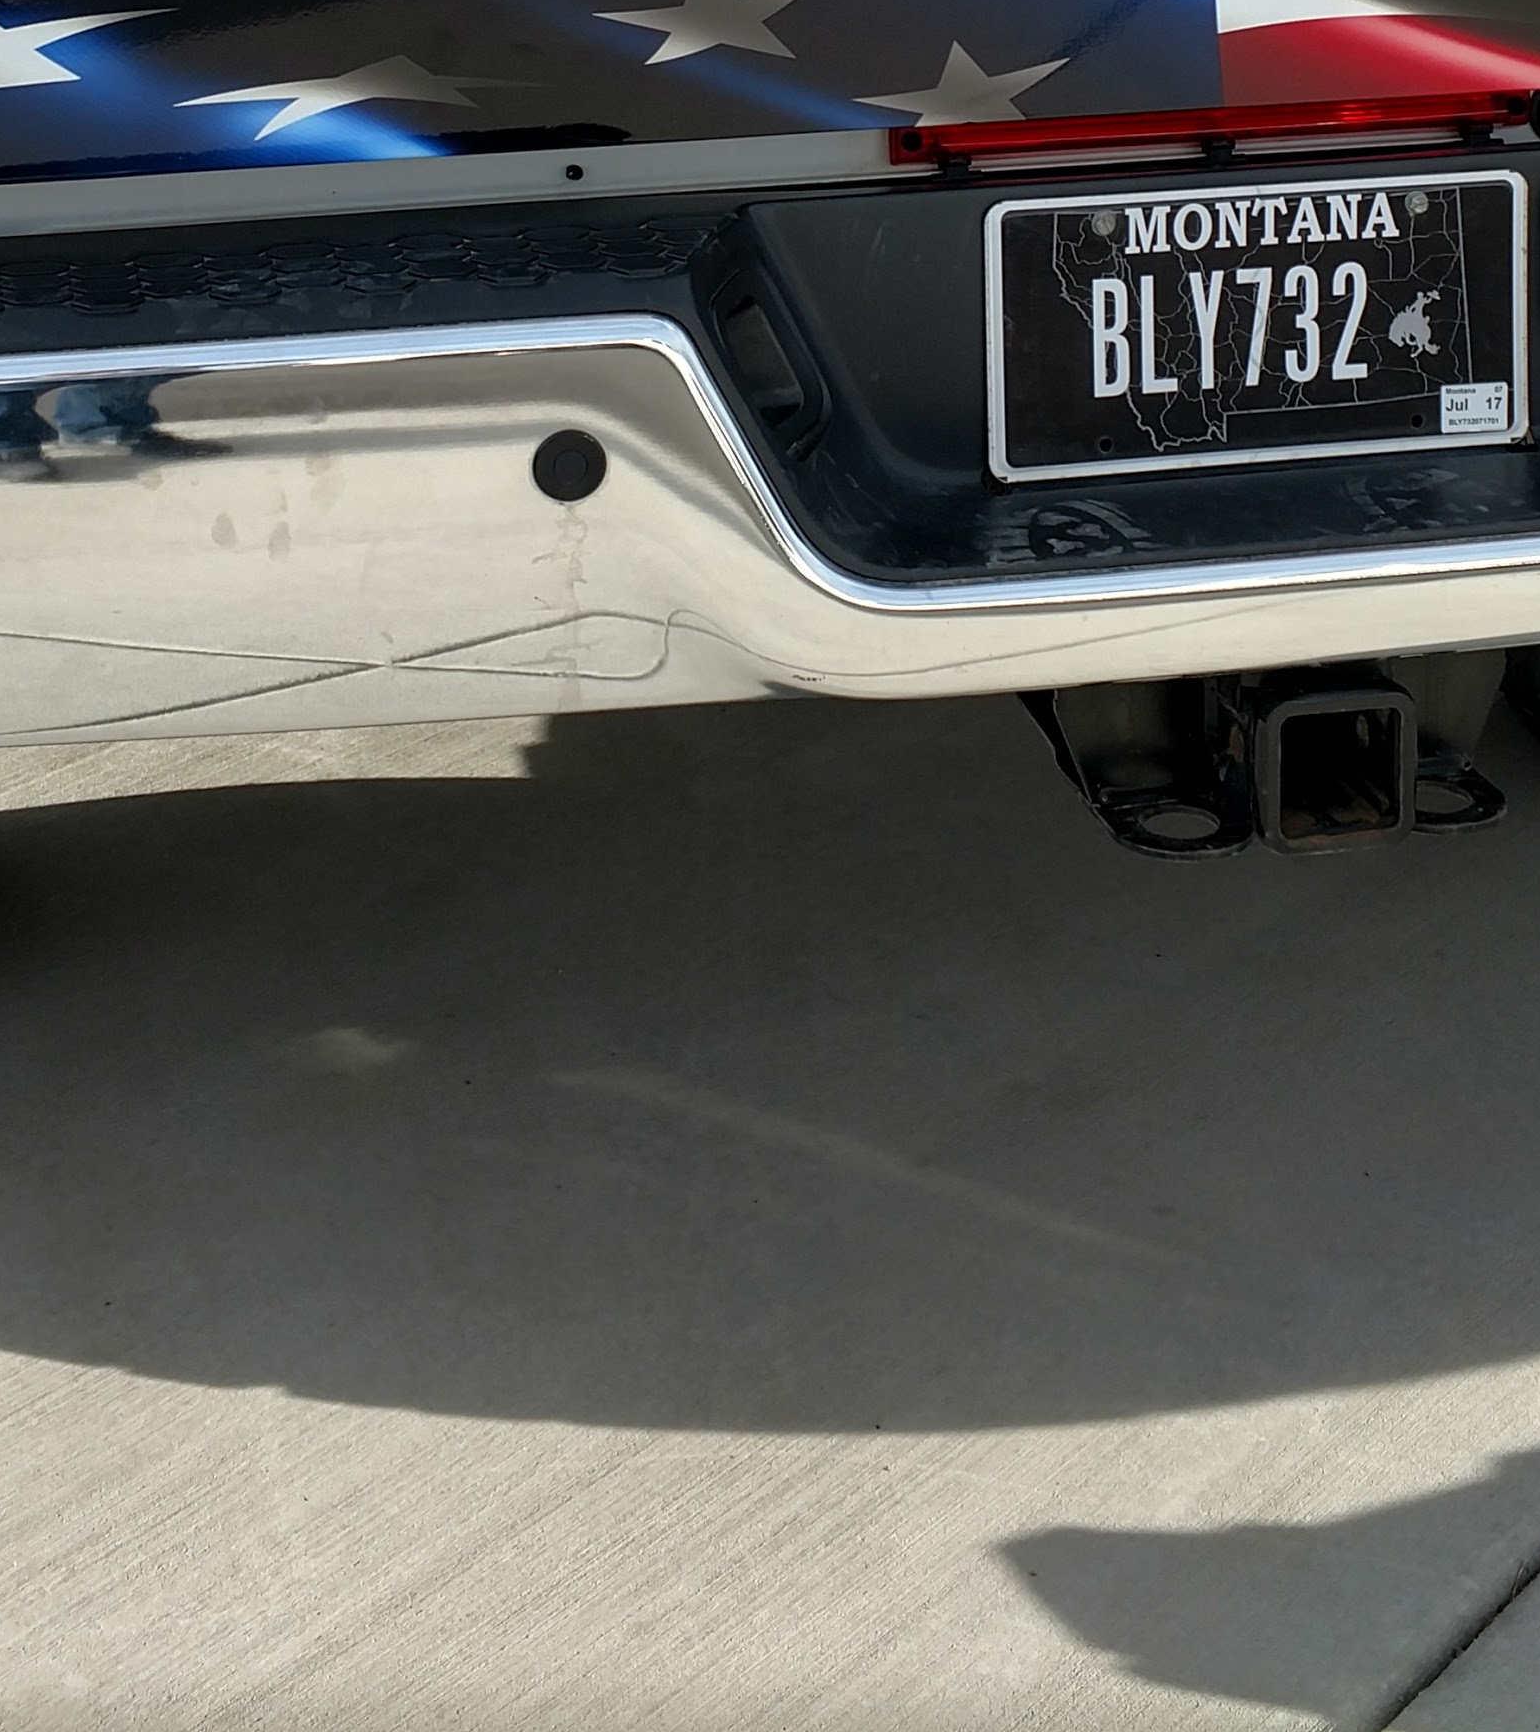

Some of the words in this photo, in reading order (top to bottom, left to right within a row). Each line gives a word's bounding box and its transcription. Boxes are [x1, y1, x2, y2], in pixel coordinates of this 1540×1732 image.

[1124, 191, 1400, 255] MONTANA
[1091, 261, 1369, 399] BLY732
[1445, 397, 1469, 412] Jul
[1485, 396, 1503, 411] 17
